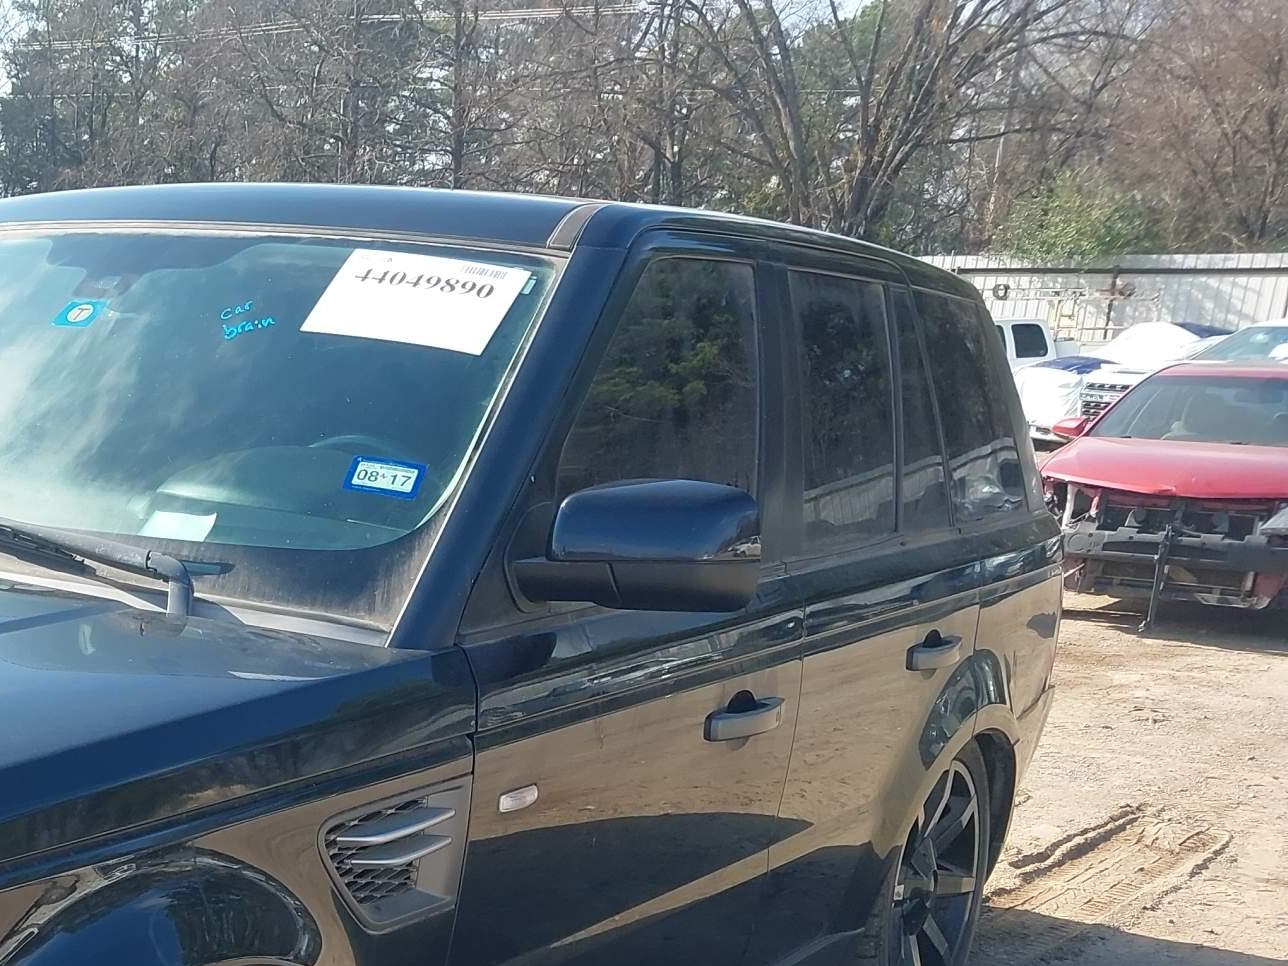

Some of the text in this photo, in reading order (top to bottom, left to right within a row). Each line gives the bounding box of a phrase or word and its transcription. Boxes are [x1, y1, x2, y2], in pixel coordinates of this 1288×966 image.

[355, 267, 494, 299] 44049890
[220, 300, 254, 320] car
[222, 316, 276, 340] brain
